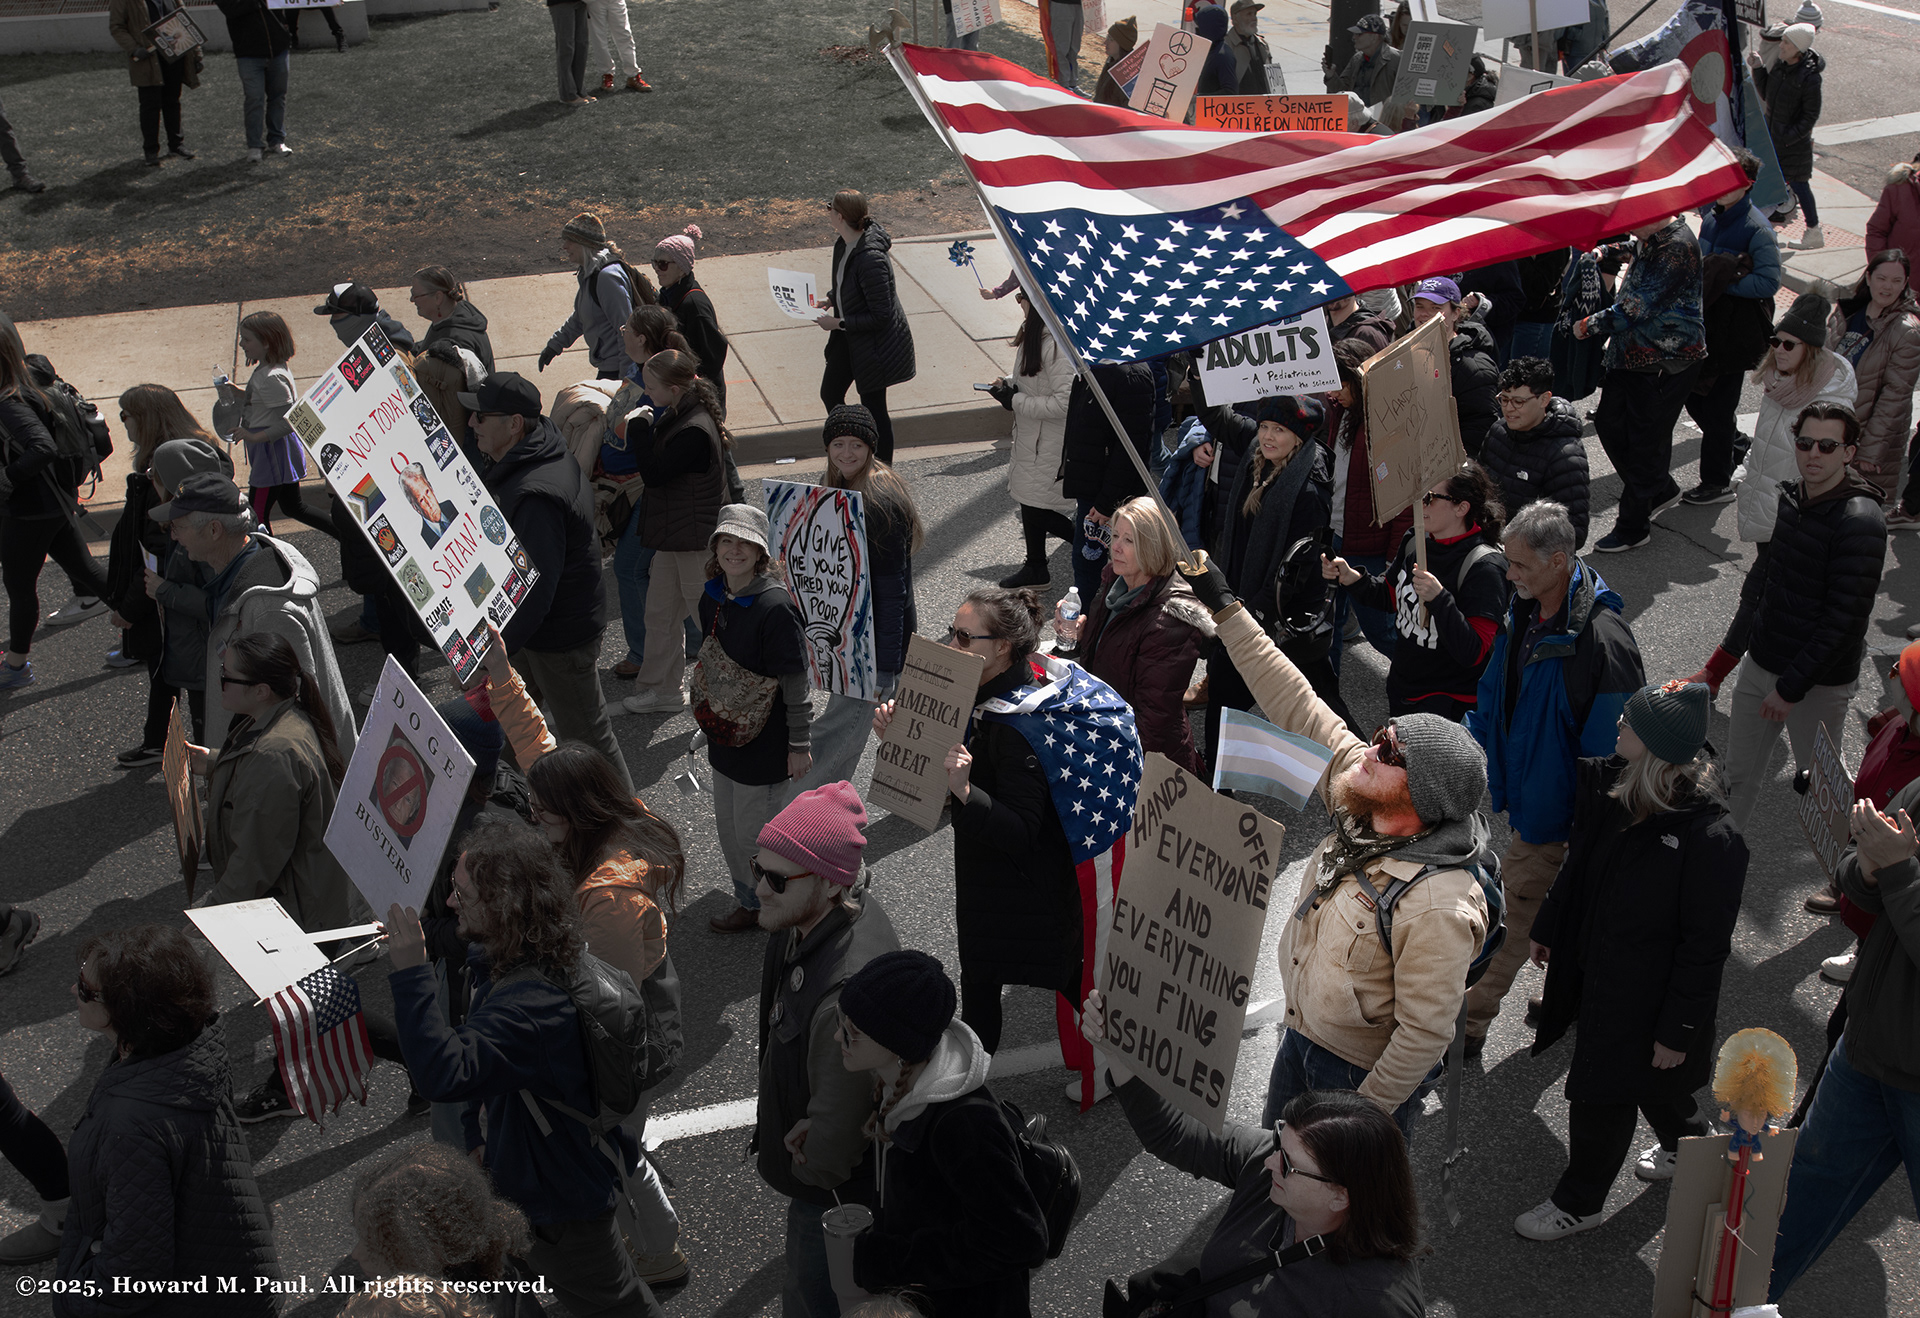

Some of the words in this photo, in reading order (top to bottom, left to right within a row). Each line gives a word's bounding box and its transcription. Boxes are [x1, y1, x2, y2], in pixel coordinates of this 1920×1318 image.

[1412, 52, 1430, 63] FREE
[1417, 42, 1431, 50] OFF!
[1204, 98, 1255, 117] HOUSE
[1265, 96, 1273, 113] &
[1279, 96, 1333, 114] SENATE
[1297, 117, 1343, 130] NOTICE
[781, 286, 805, 314] OFF!
[1206, 327, 1320, 371] ADULTS
[1267, 369, 1321, 381] Pediatrician
[288, 405, 303, 424] BLACK
[1374, 382, 1418, 431] HANDS
[305, 423, 323, 445] MATTER
[347, 422, 376, 467] NOT
[369, 389, 407, 434] TODAY
[370, 526, 378, 538] NO
[374, 515, 388, 533] KINGS
[482, 510, 497, 529] SCIENCE
[491, 517, 502, 534] REAL
[387, 542, 405, 566] AMERICA
[433, 513, 482, 588] SATAN!
[507, 539, 518, 555] LOVE
[812, 524, 848, 562] GIVE
[525, 567, 537, 585] LOVE
[792, 555, 806, 570] ME
[813, 558, 848, 579] YOUR
[794, 573, 824, 593] TIRED,
[827, 579, 850, 600] YOUR
[491, 591, 502, 607] BLACK
[497, 599, 506, 613] LIVES
[810, 597, 838, 623] POOR
[425, 596, 451, 628] CLIMATE
[500, 604, 512, 622] MATTER
[443, 631, 458, 653] TRANS
[447, 637, 463, 660] RIGHTS
[451, 651, 461, 666] ARE
[455, 649, 471, 672] HUMAN
[460, 656, 475, 679] RIGHTS
[894, 688, 960, 728] AMERICA
[392, 687, 455, 778] DOGE
[907, 718, 924, 740] IS
[881, 741, 930, 776] GREAT
[1810, 760, 1838, 827] NOT
[1134, 768, 1187, 848] HANDS
[1239, 812, 1269, 870] OFF
[355, 801, 411, 884] BUSTERS
[1157, 824, 1269, 910] EVERYONE
[1165, 888, 1212, 938] AND
[1113, 897, 1249, 1007] EVERYTHING
[1109, 952, 1141, 997] YOU
[1157, 981, 1217, 1048] F'ING
[1103, 995, 1225, 1108] ASSHOLES
